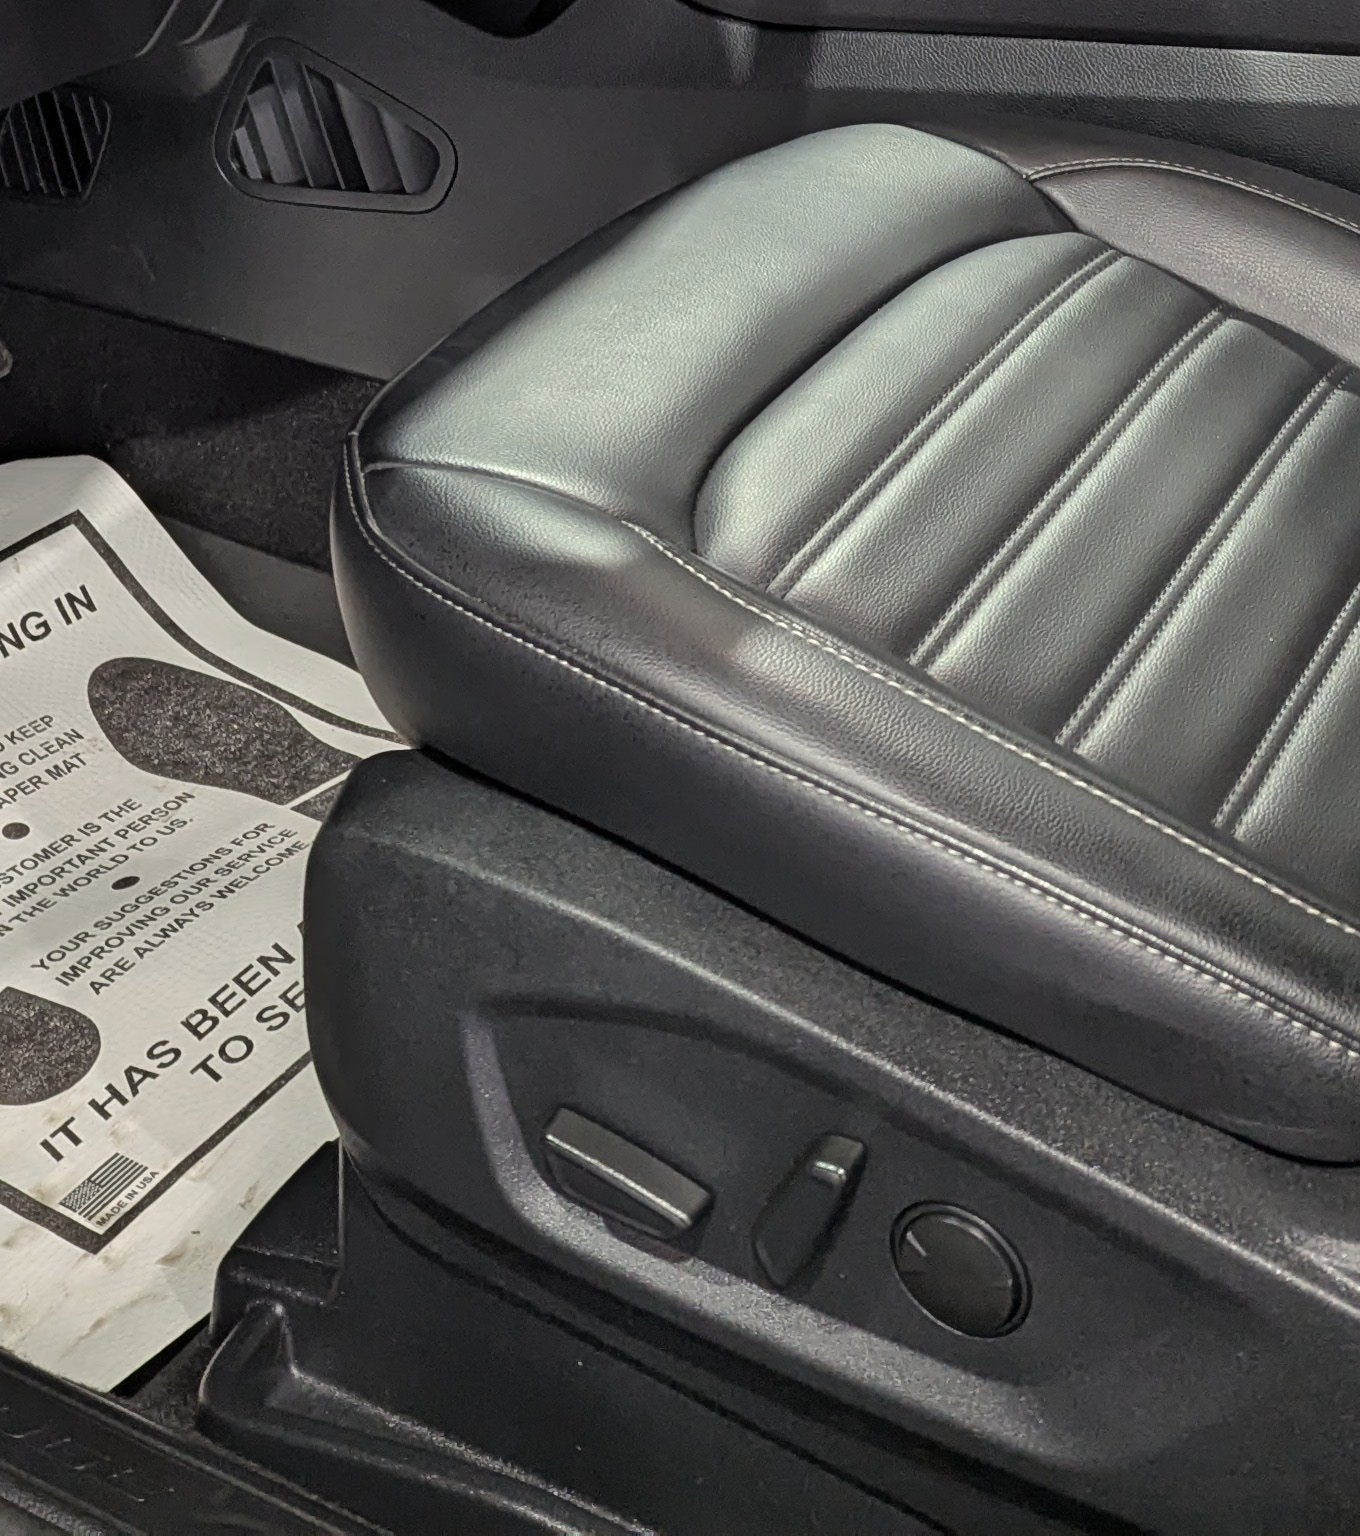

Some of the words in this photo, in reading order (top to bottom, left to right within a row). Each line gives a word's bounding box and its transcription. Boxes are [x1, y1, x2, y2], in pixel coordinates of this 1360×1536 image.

[54, 585, 98, 626] IN
[4, 714, 54, 745] KEEP
[18, 728, 85, 767] CLEAN
[45, 752, 88, 781] MAT
[77, 821, 102, 837] IS
[97, 798, 143, 823] THE
[2, 837, 116, 908] IMPORTANT
[114, 791, 196, 840] PERSON
[8, 897, 58, 924] THE
[52, 853, 130, 898] WORLD
[126, 836, 158, 854] TO
[155, 817, 194, 836] US.
[30, 930, 97, 972] YOUR
[93, 846, 233, 931] SUGGESTIONS
[230, 822, 276, 847] FOR
[54, 905, 171, 987] IMPROVING
[169, 876, 218, 905] OUR
[213, 828, 299, 877] SERVICE
[88, 956, 136, 996] ARE
[133, 901, 215, 960] ALWAYS
[209, 840, 310, 900] WELCOME
[39, 1116, 83, 1162] IT
[88, 1039, 182, 1121] HAS
[180, 942, 296, 1041] BEEN
[190, 1034, 254, 1083] TO
[95, 1199, 128, 1226] MADE
[125, 1189, 139, 1201] IN
[137, 1170, 160, 1191] USA
